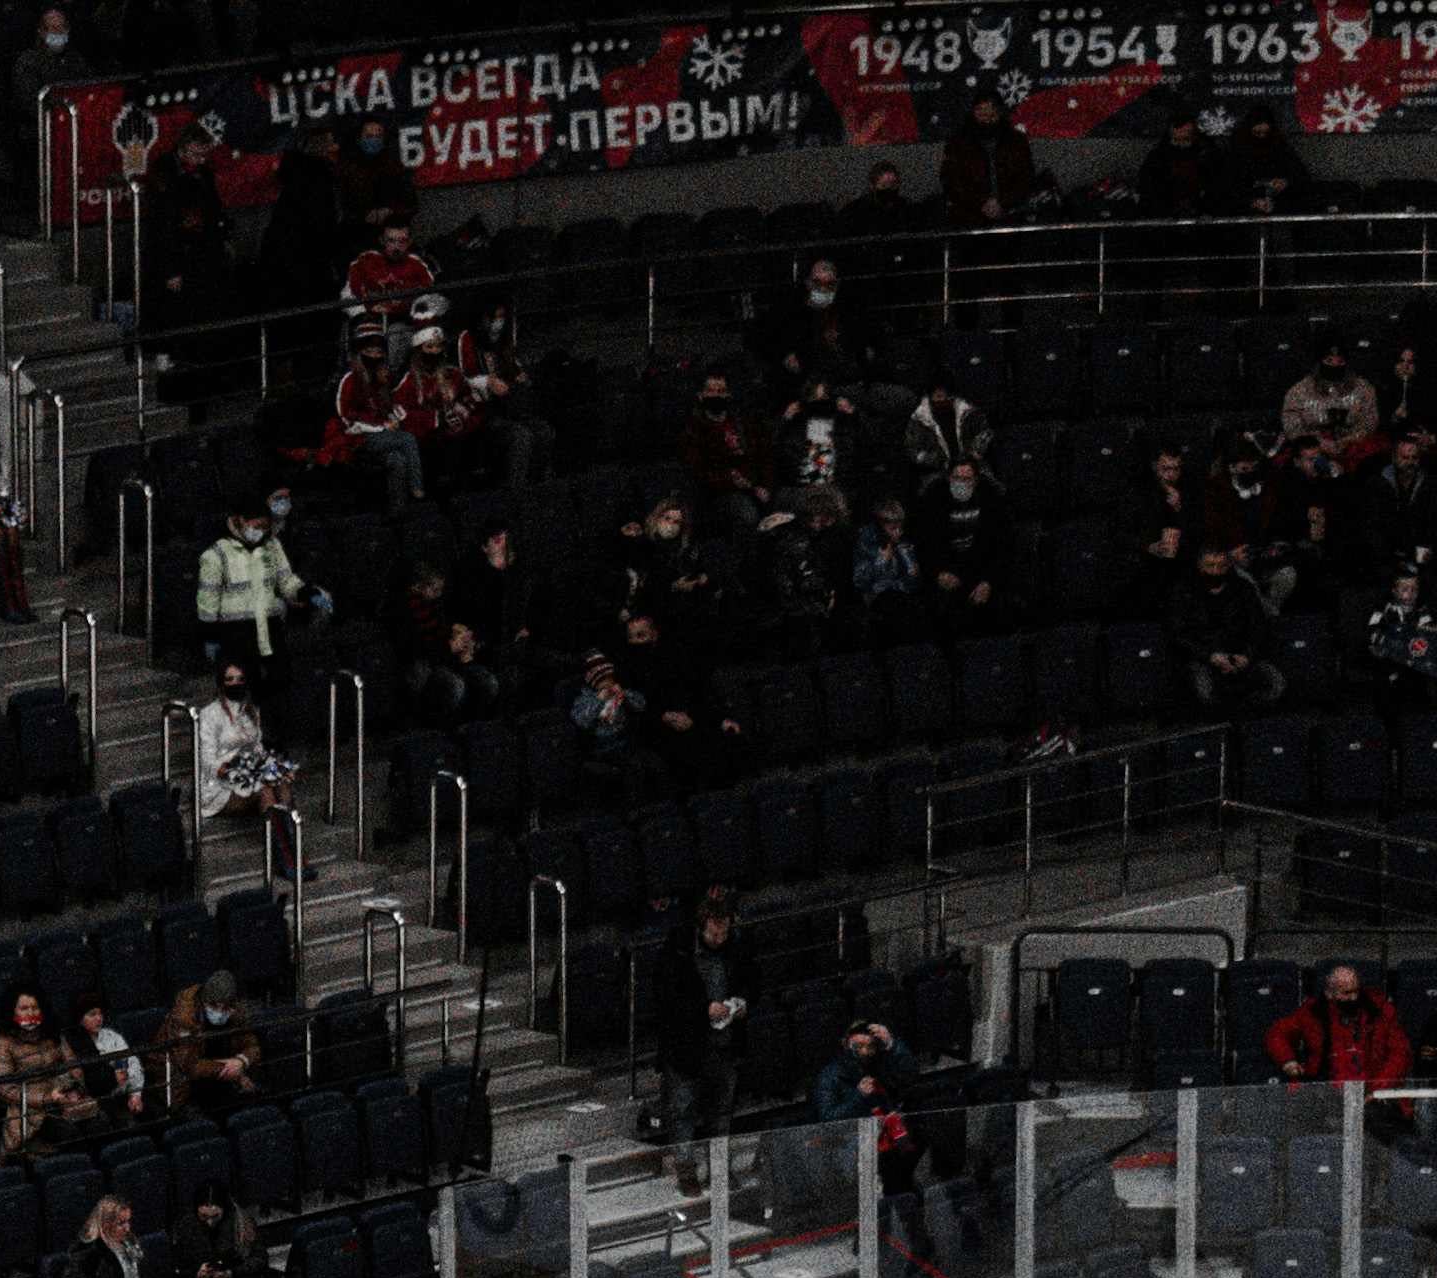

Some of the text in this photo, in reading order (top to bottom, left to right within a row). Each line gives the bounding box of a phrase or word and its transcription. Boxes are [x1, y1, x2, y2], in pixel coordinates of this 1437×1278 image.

[849, 31, 962, 75] 1948
[1031, 26, 1146, 67] 1954
[1204, 22, 1320, 64] 1963
[269, 53, 600, 127] ЦСКА ВСЕГДА
[399, 92, 800, 169] БУДЕТ ПЕРВЫМ!
